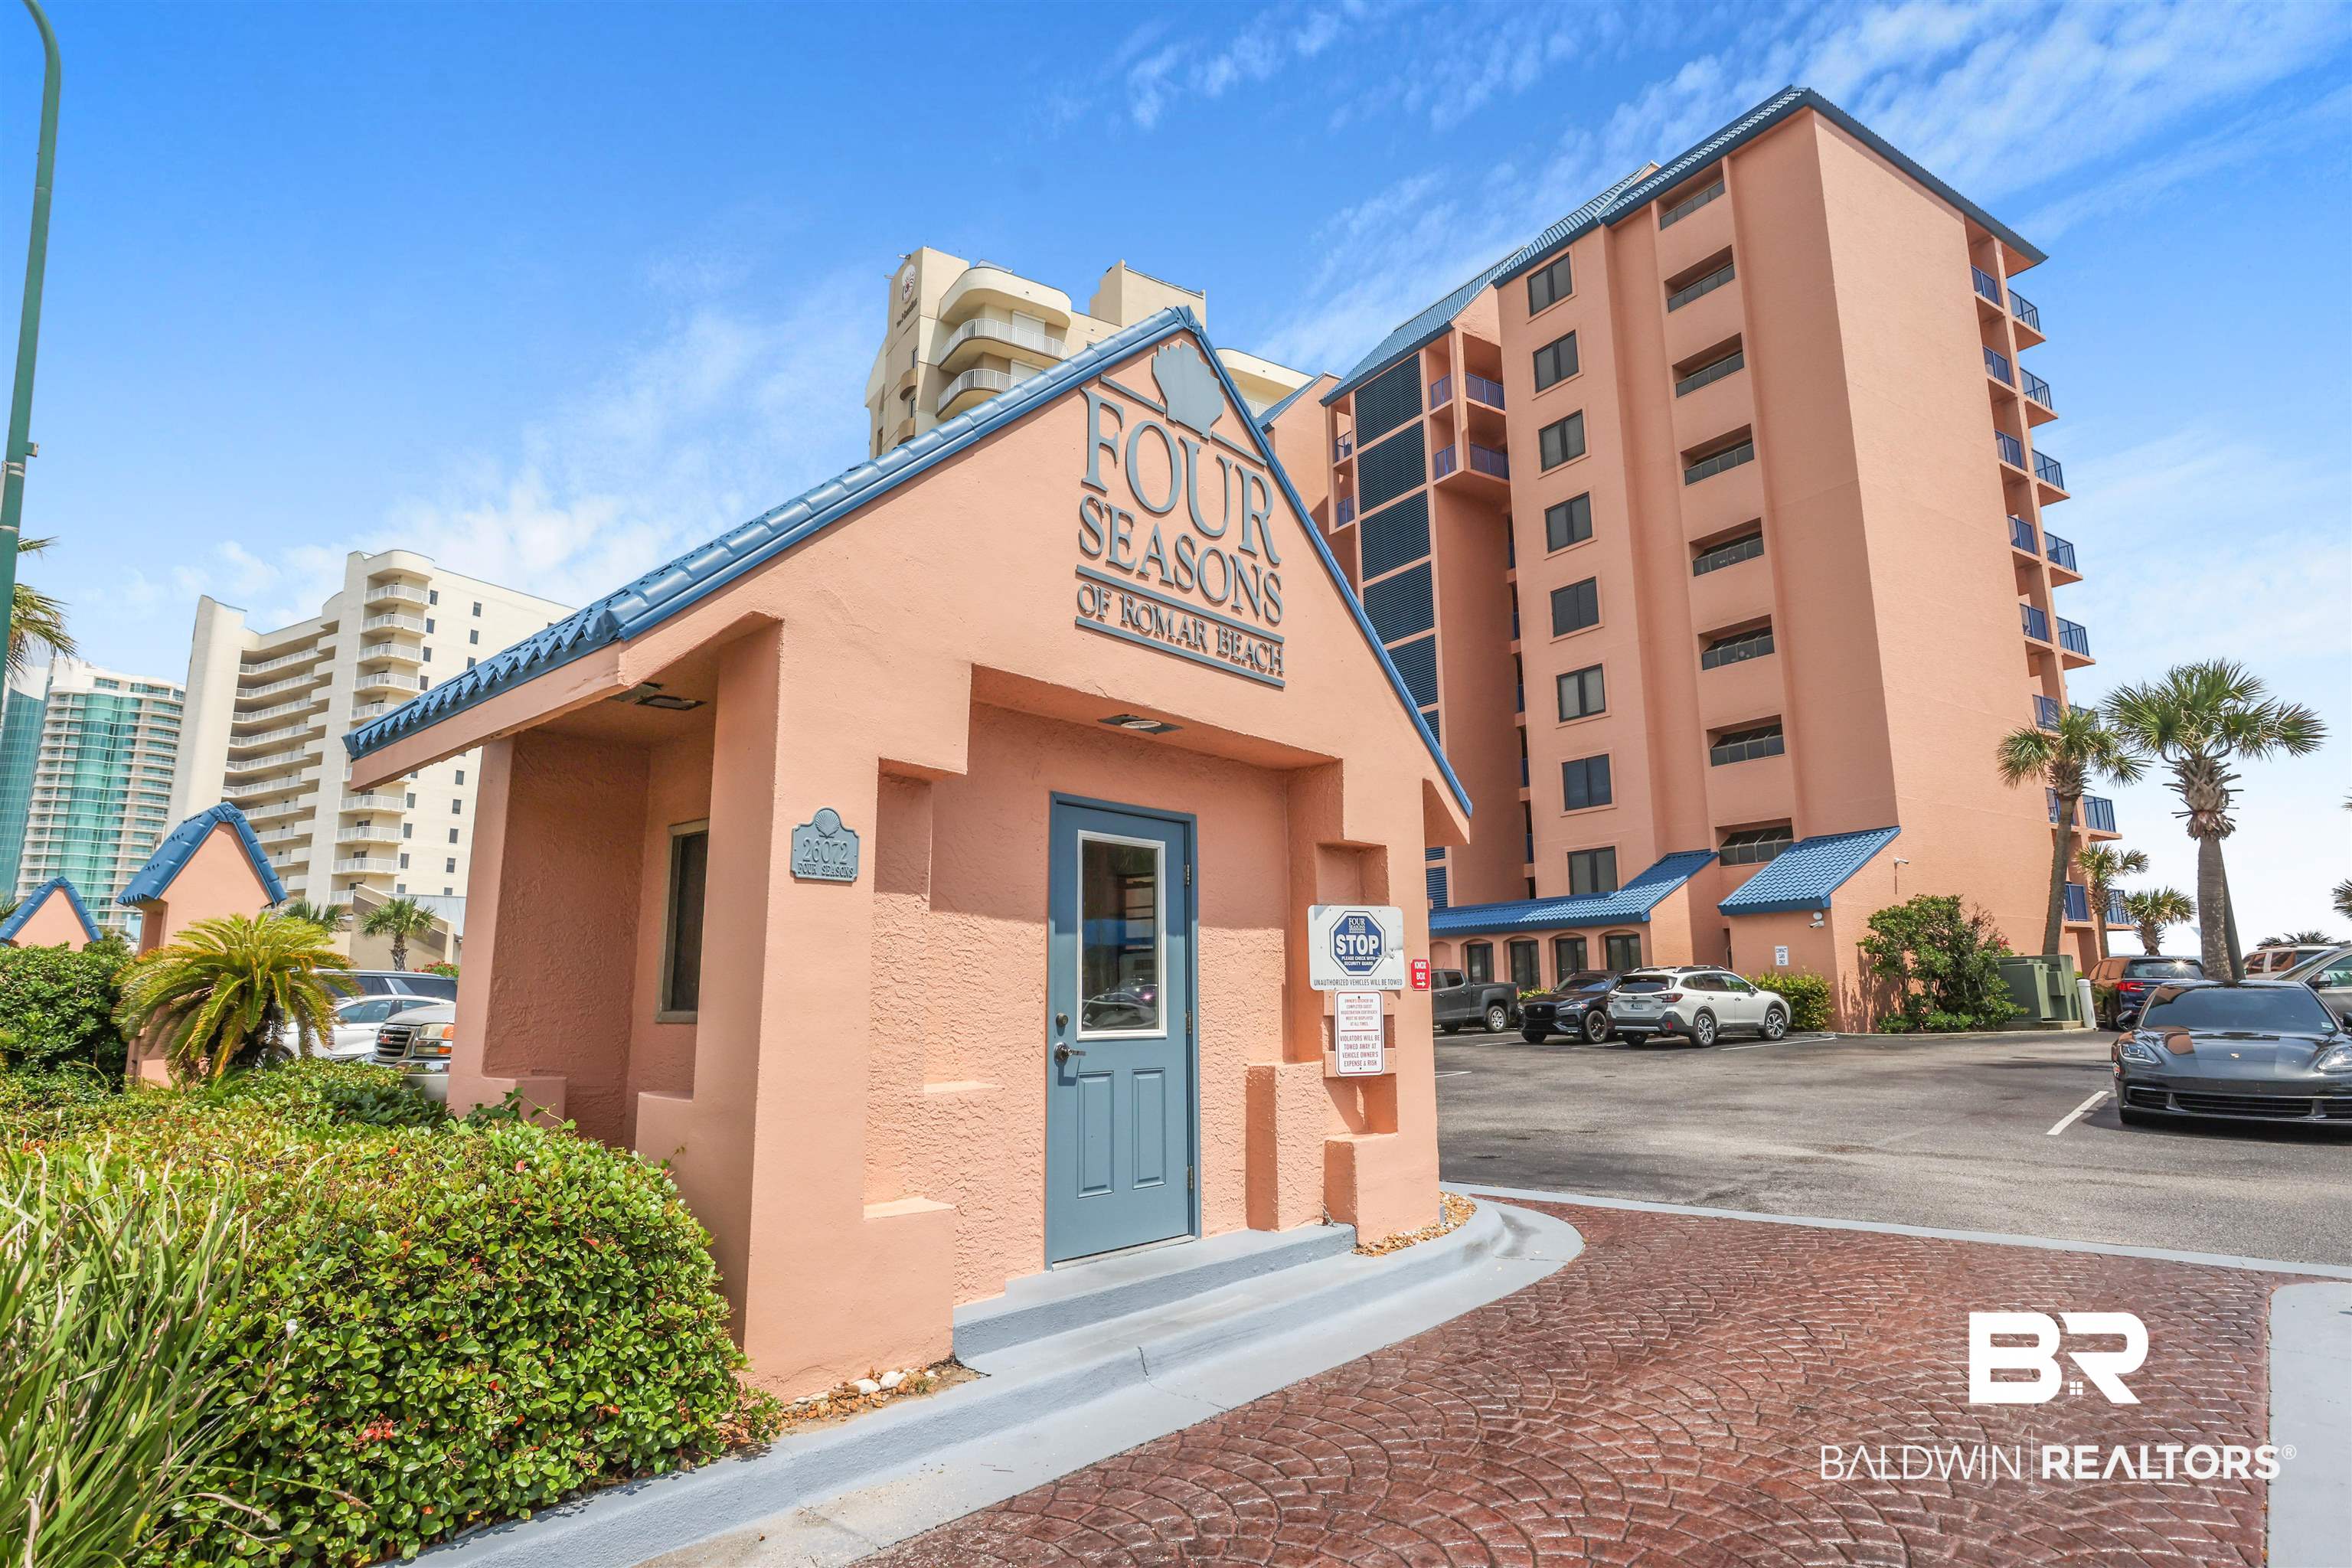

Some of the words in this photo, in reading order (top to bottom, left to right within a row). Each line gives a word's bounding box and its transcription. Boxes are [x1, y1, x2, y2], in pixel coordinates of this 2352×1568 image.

[1080, 386, 1281, 564] FOUR
[1078, 494, 1283, 624] SEASONS
[1077, 582, 1112, 618] OF
[1120, 593, 1208, 650] ROMAR
[1217, 624, 1285, 674] BEACH
[802, 838, 848, 865] 26072
[797, 862, 817, 875] FOUR
[821, 864, 854, 878] SEASONS
[1335, 934, 1379, 956] STOP
[1414, 961, 1426, 969] KNOX
[1416, 972, 1426, 980] BOX
